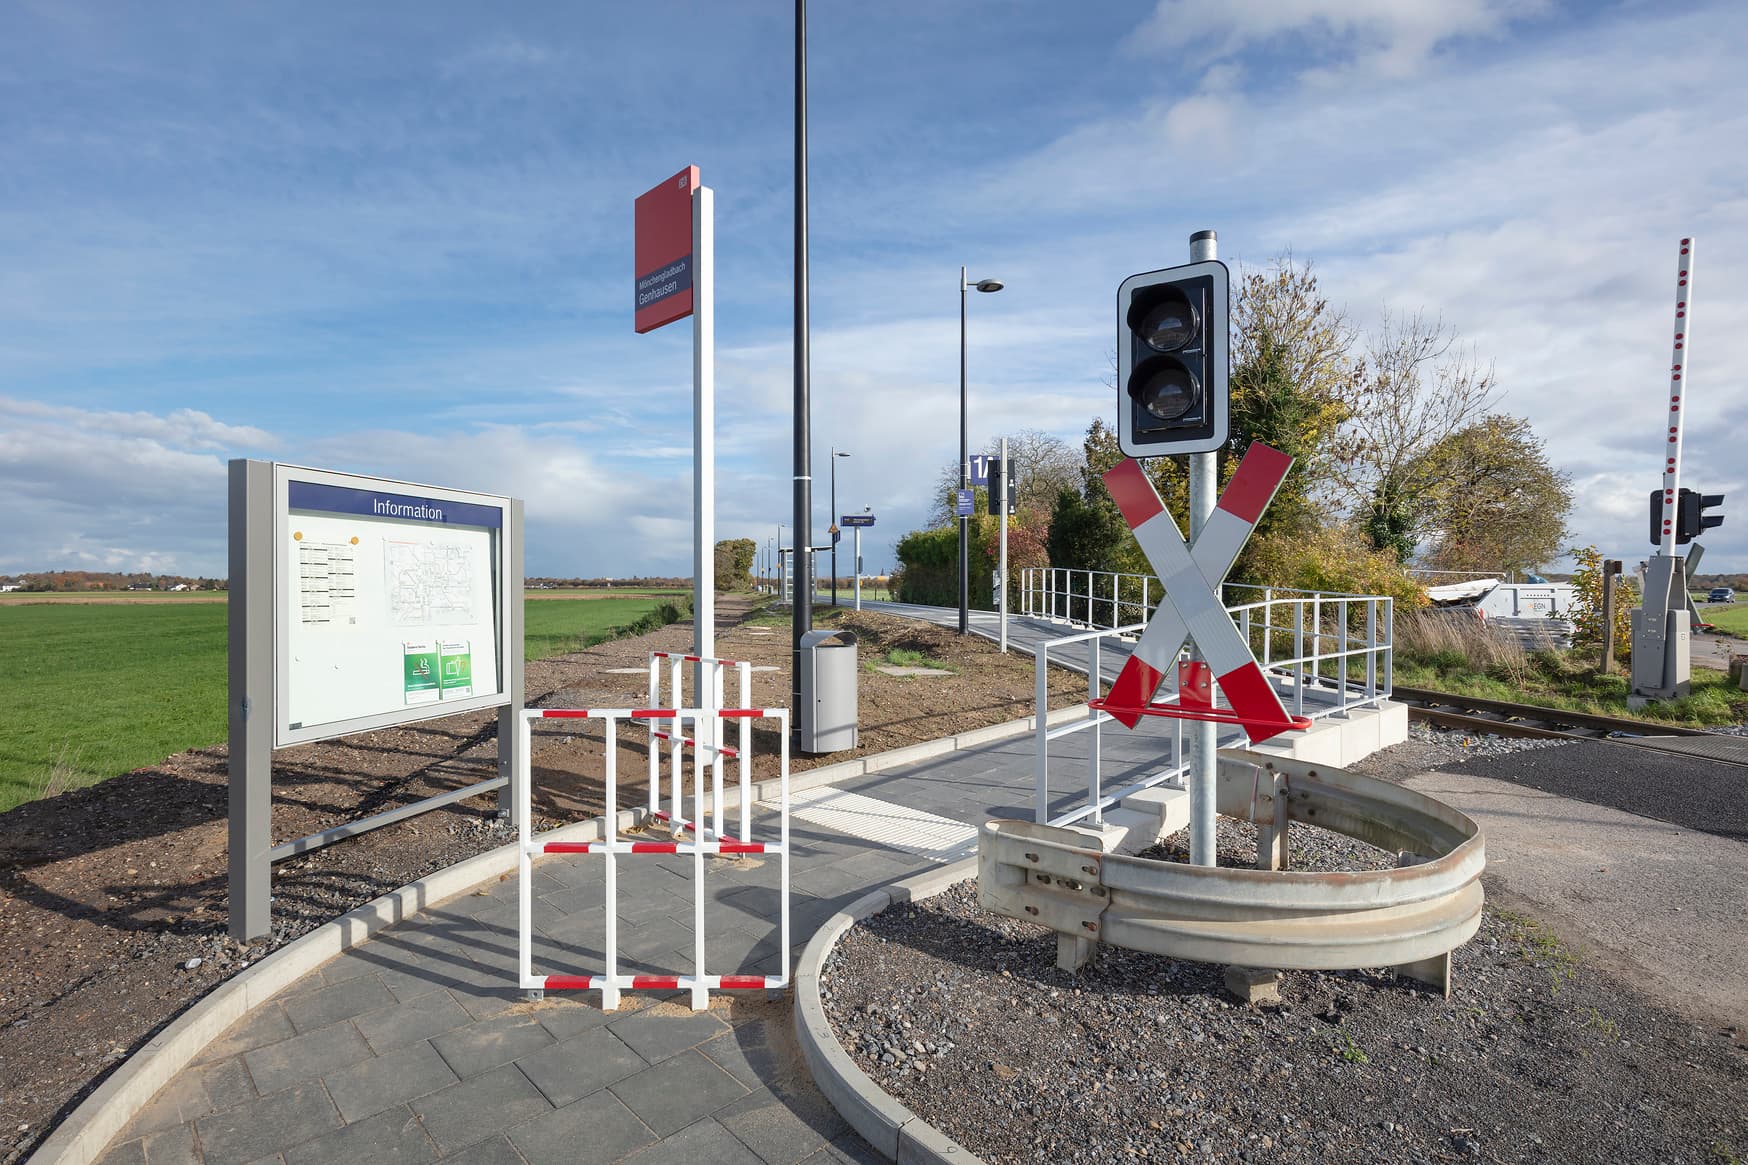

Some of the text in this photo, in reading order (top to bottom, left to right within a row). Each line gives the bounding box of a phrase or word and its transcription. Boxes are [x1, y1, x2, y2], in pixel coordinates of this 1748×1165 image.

[639, 261, 685, 290] Mönchengladbach
[639, 280, 677, 305] Genhausen
[374, 498, 442, 520] Information
